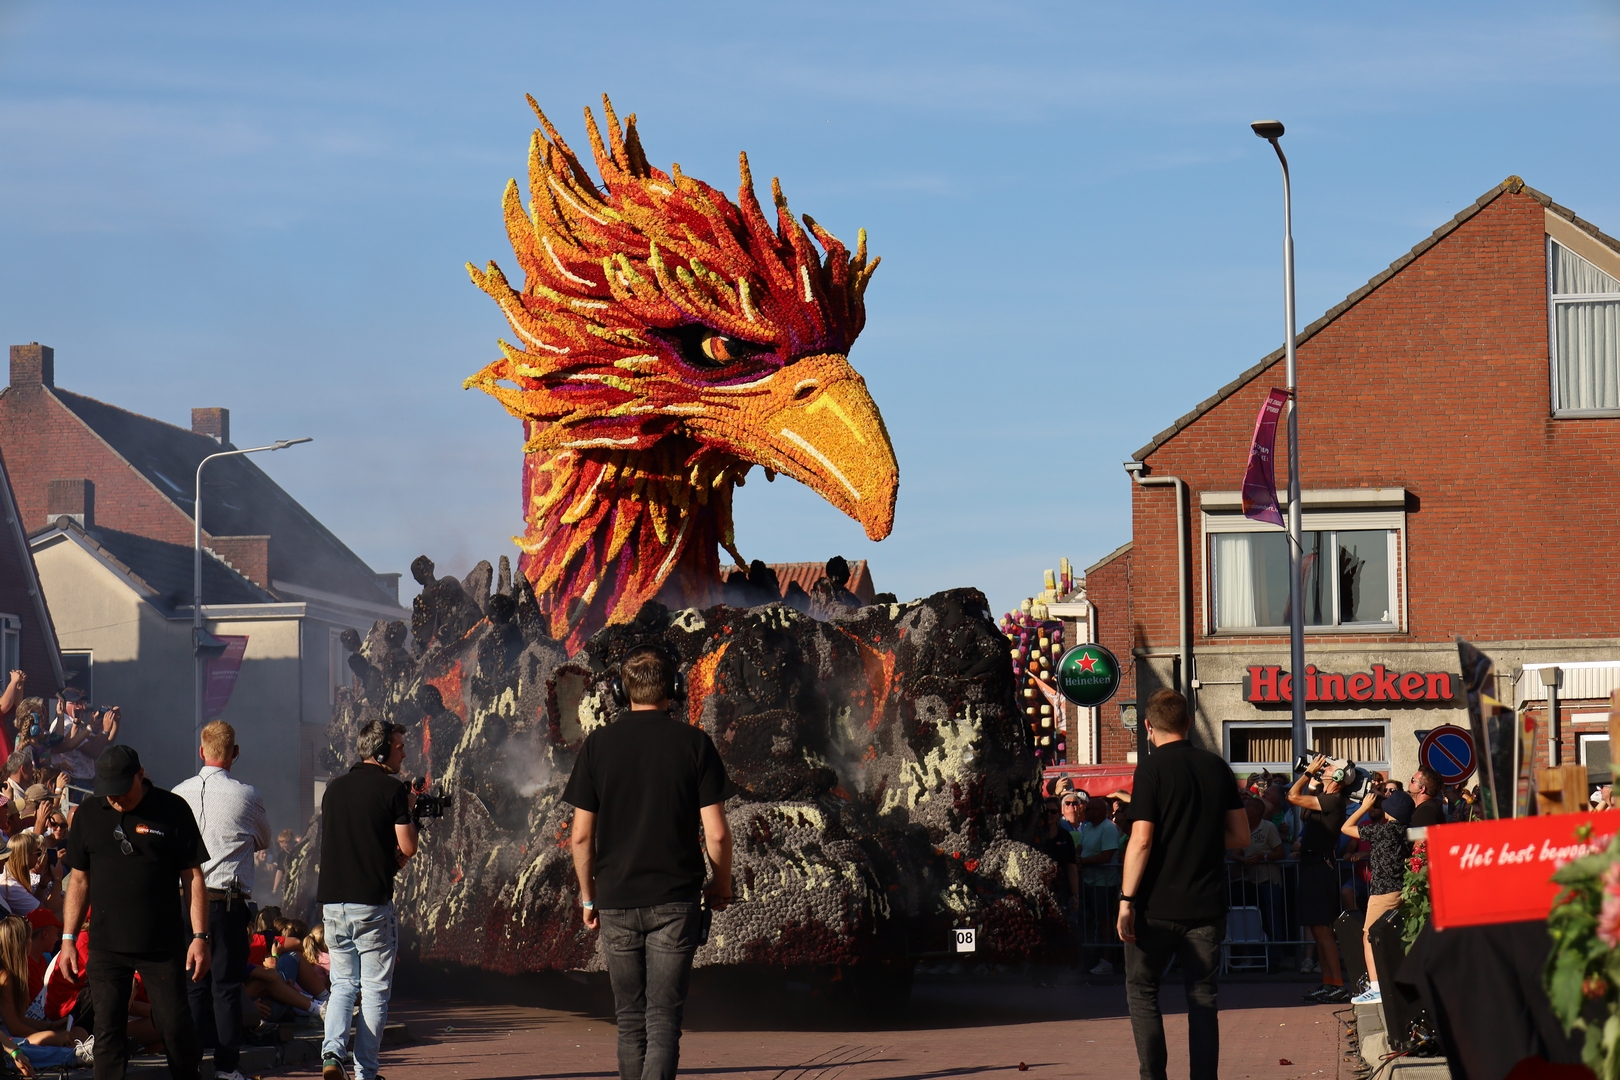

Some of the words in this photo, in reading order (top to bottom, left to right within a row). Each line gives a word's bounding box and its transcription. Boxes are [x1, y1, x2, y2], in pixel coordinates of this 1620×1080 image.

[1065, 675, 1111, 686] Heineken
[1498, 842, 1535, 865] best
[957, 932, 973, 944] 08
